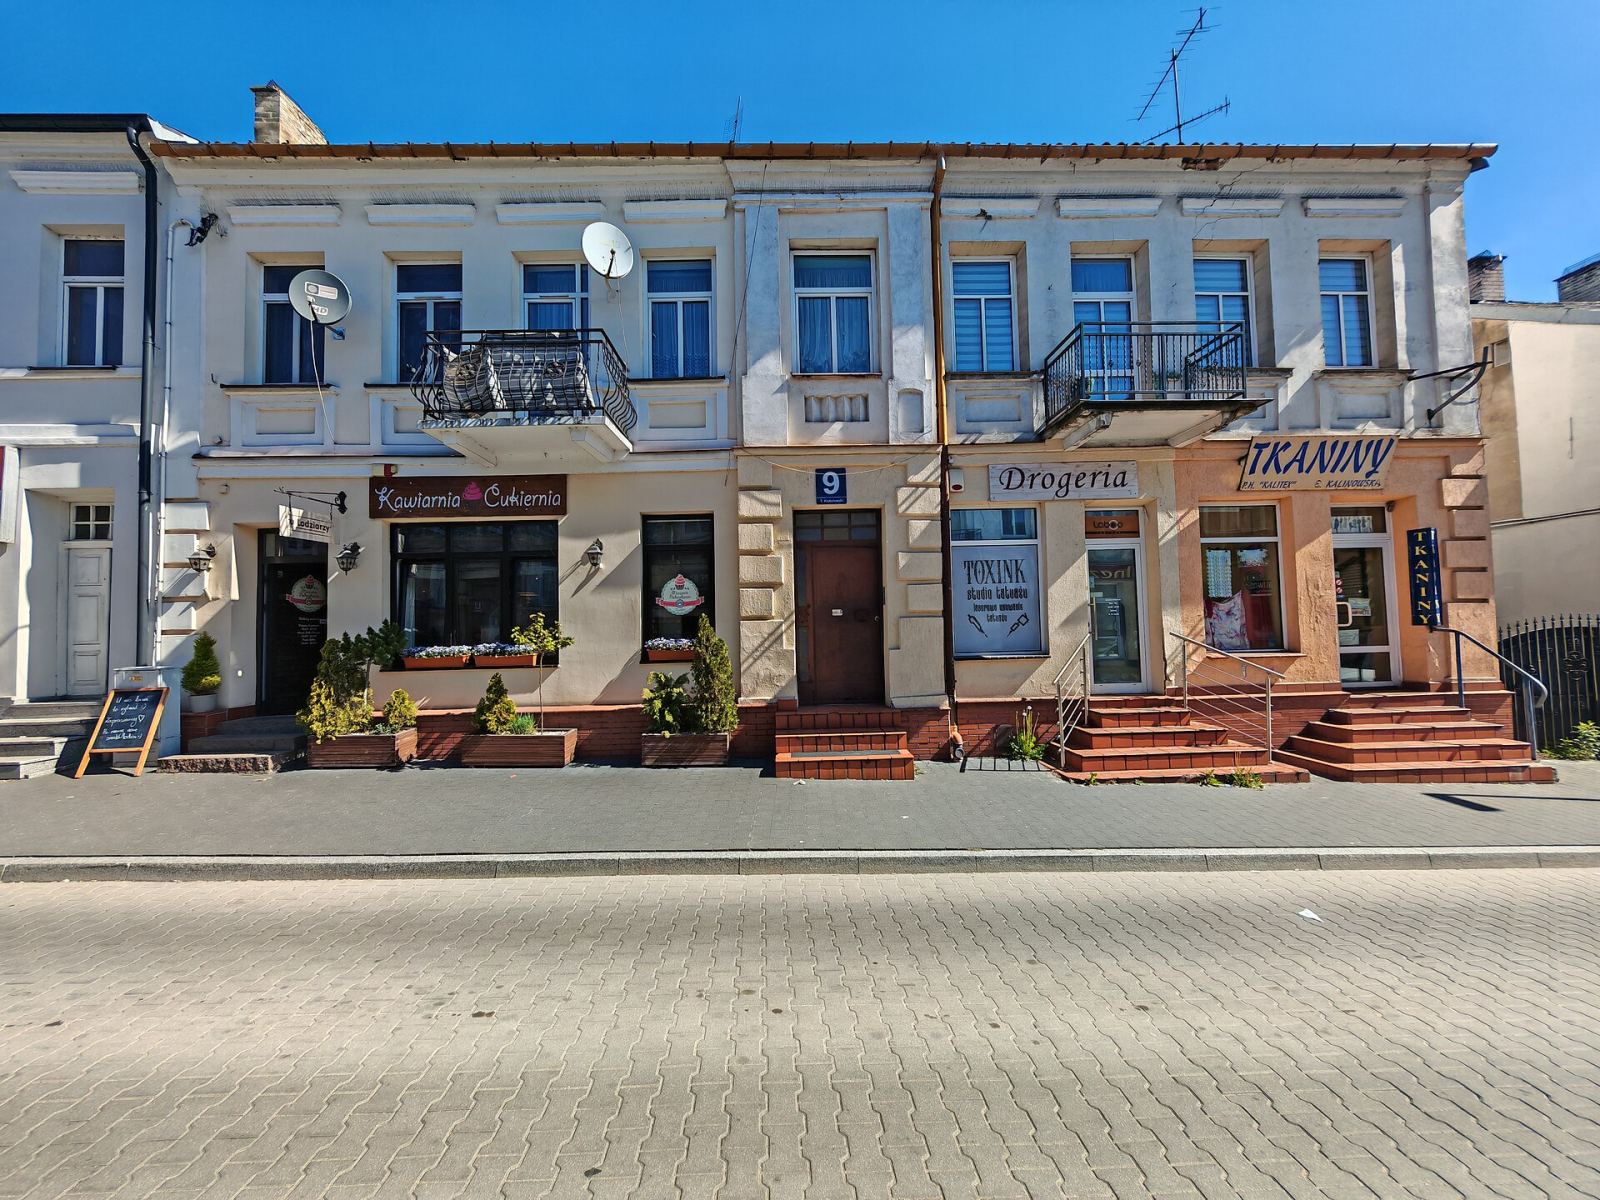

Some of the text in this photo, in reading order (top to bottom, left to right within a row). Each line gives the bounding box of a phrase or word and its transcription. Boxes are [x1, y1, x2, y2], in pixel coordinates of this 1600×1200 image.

[1248, 438, 1395, 479] TKANINY
[822, 471, 840, 495] 9
[999, 463, 1128, 498] Drogeria
[1326, 479, 1382, 489] KALINOWSKA
[375, 483, 561, 512] Kawiarnia Cukiernia
[963, 558, 1026, 585] TOXINK
[1413, 531, 1432, 625] TKANINY
[967, 587, 993, 600] studio
